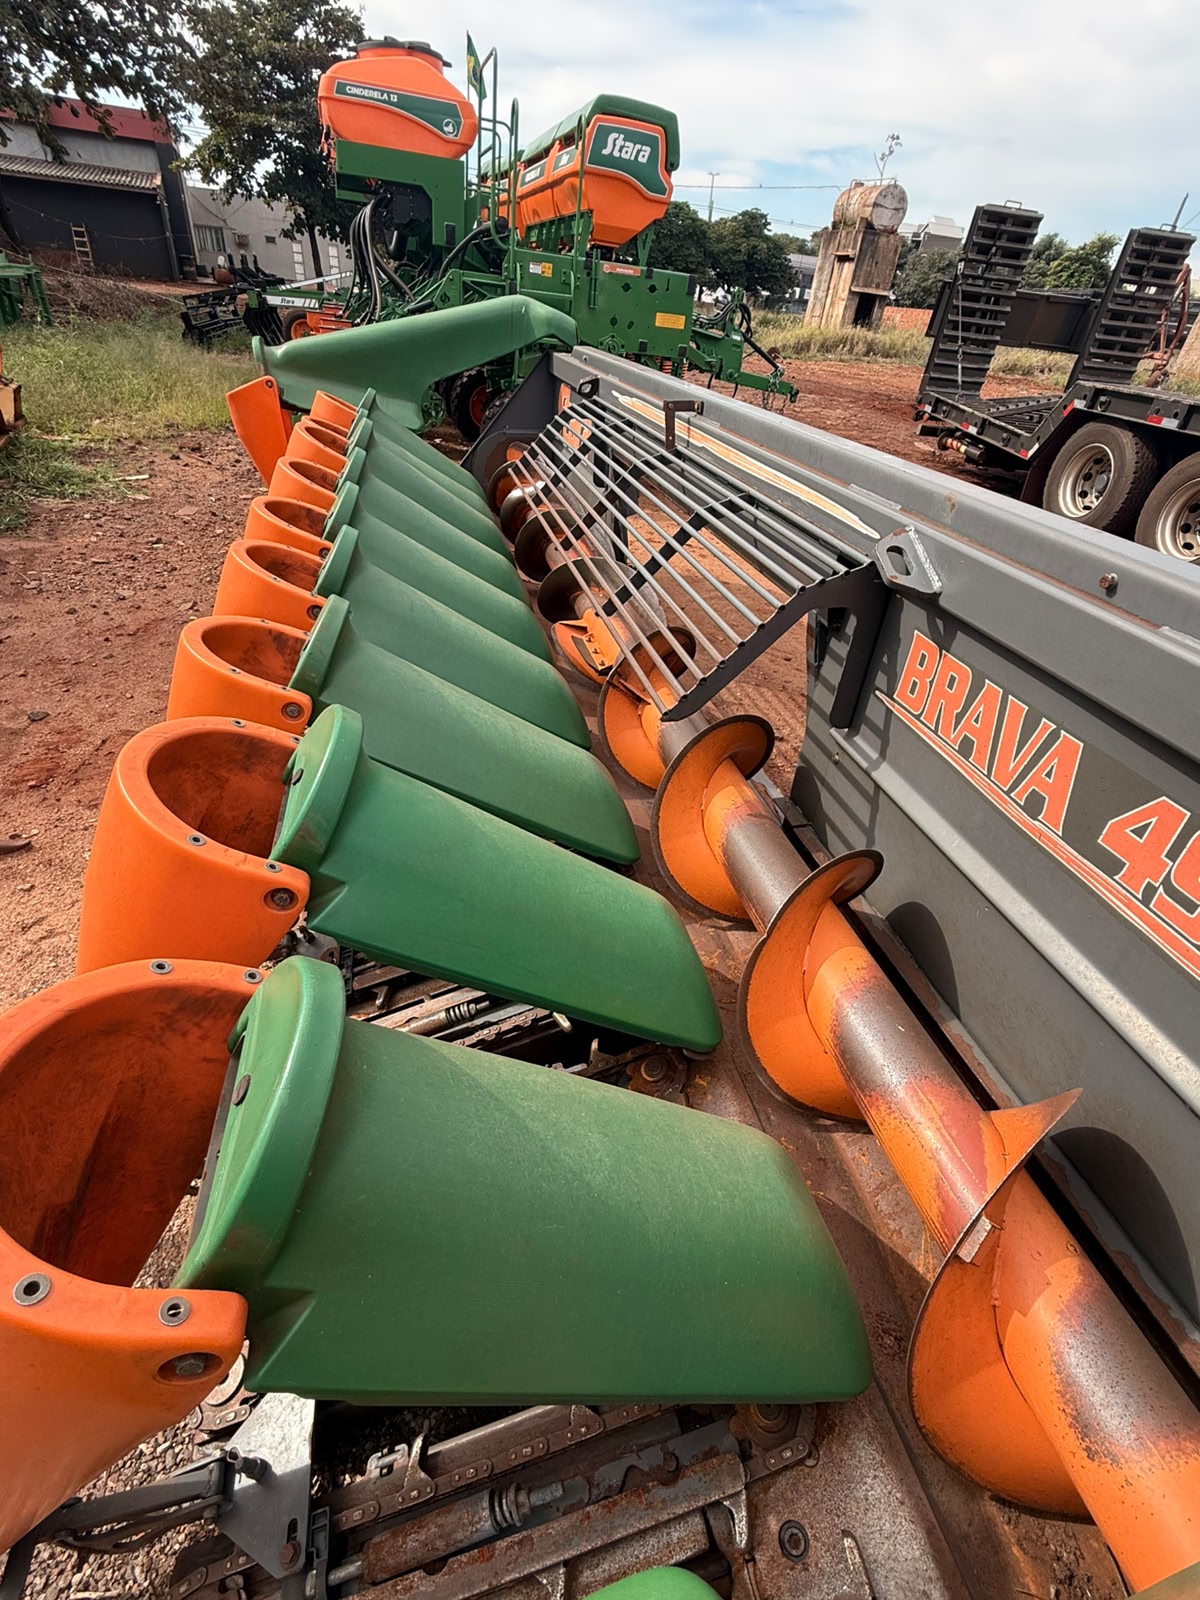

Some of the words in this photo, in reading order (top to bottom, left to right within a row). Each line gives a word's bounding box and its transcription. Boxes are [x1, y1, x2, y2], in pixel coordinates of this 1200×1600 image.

[346, 86, 388, 100] CINDERELA
[390, 94, 398, 102] 13
[601, 132, 651, 164] Stara
[893, 629, 1084, 837] BRAVA
